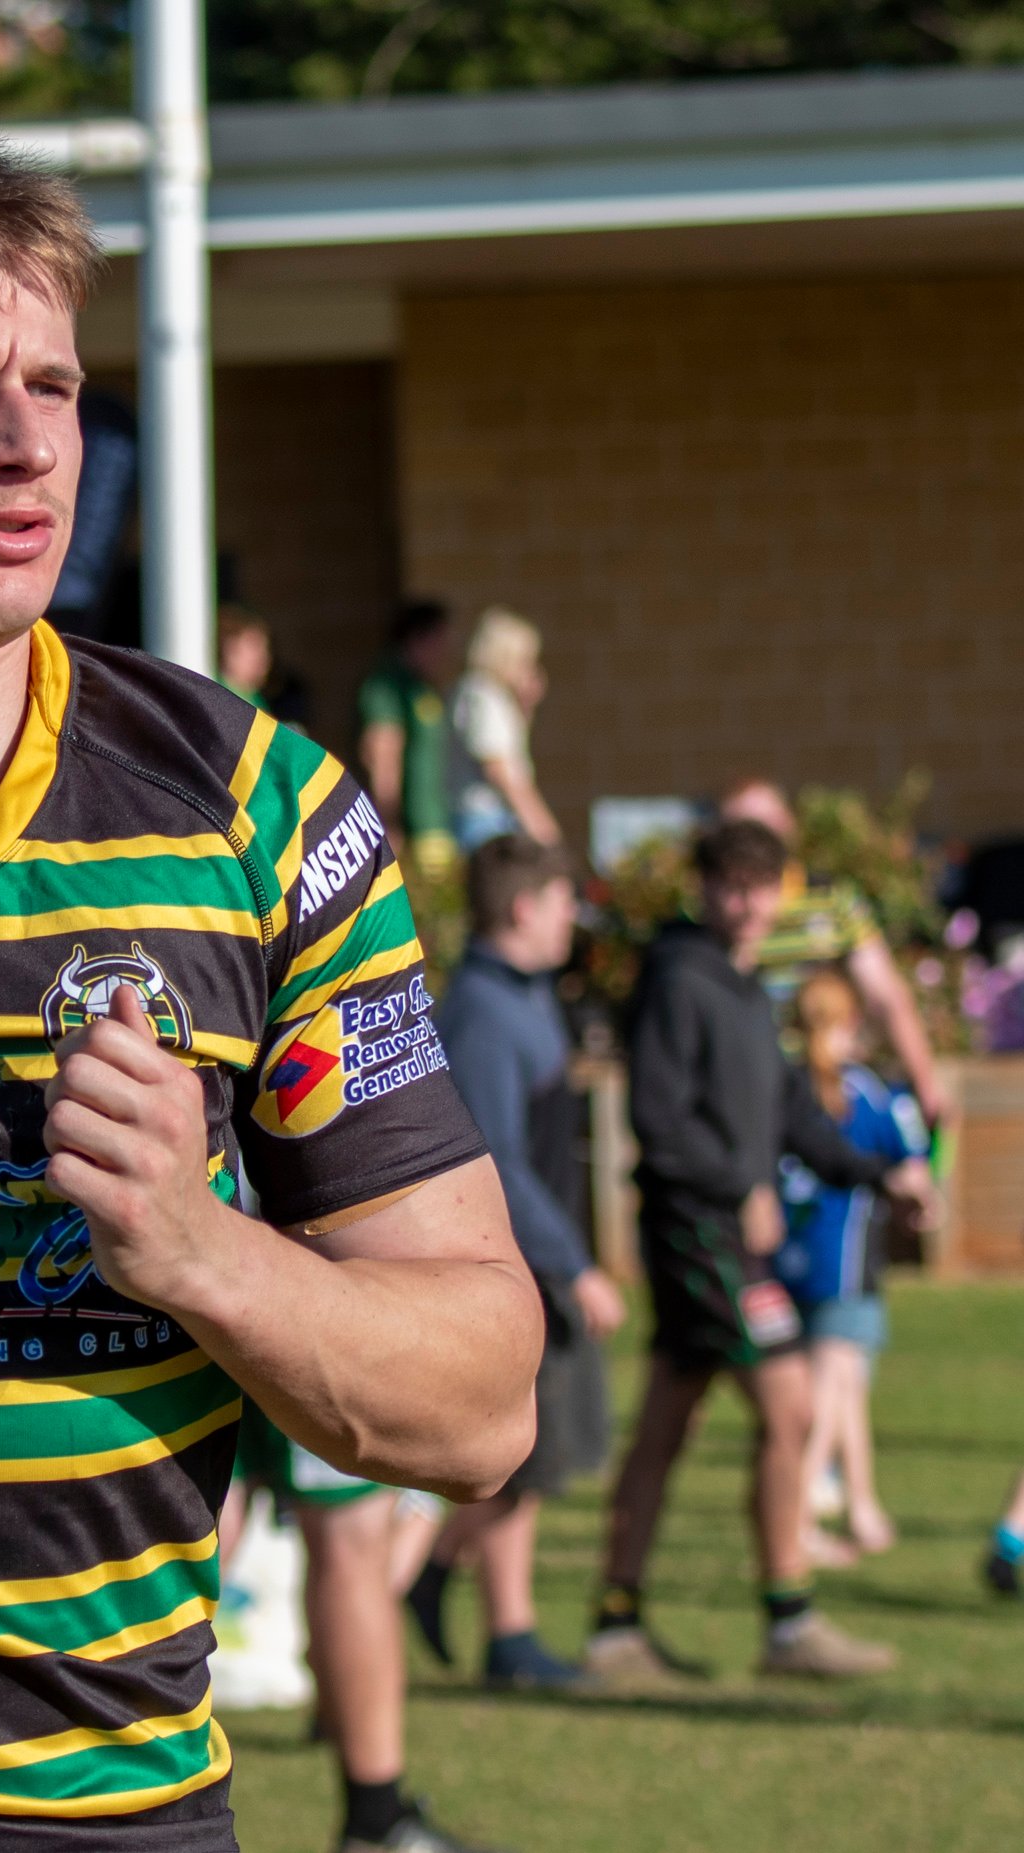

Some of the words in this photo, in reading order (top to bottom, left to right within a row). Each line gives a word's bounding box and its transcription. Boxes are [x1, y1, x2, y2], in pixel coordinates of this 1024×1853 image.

[339, 997, 406, 1037] Easy
[342, 1046, 425, 1106] General
[78, 1319, 171, 1356] CLUB
